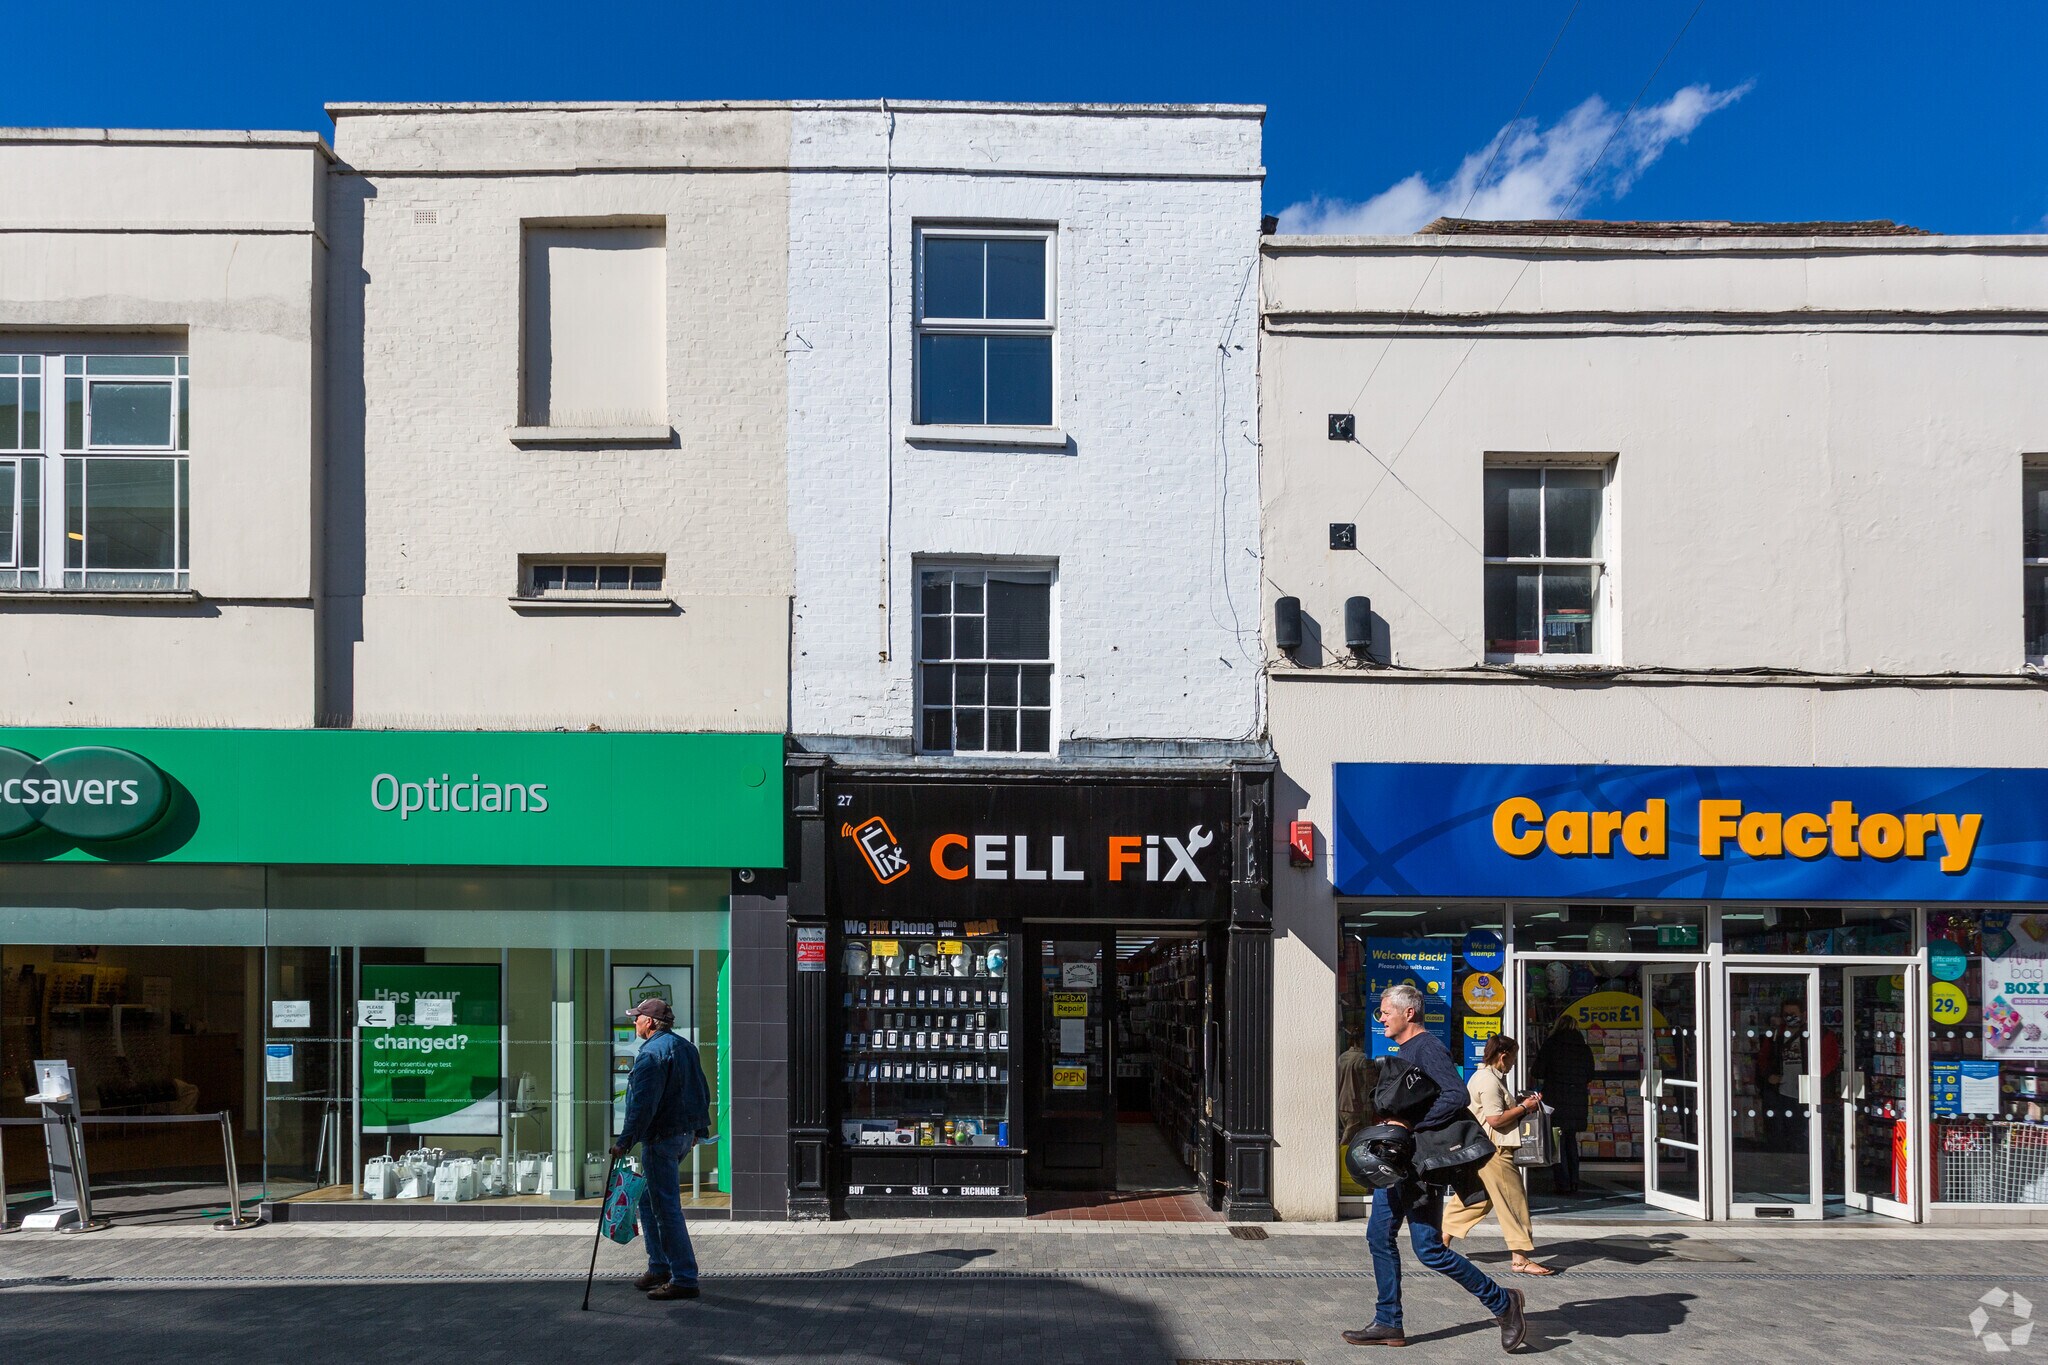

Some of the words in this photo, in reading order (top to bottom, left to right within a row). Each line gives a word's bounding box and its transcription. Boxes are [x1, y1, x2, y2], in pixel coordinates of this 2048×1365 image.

[0, 779, 139, 805] csavers
[371, 773, 548, 820] Opticians
[837, 795, 853, 806] 27
[1492, 796, 1666, 858] Card
[1699, 799, 1982, 873] Factory
[930, 834, 1085, 881] CELL
[844, 920, 866, 934] We
[869, 920, 889, 935] FIX
[891, 920, 934, 935] Phone
[938, 920, 957, 928] while
[799, 943, 824, 951] Alarm
[1372, 950, 1417, 961] Welcome
[1418, 952, 1447, 962] Back!
[1065, 964, 1094, 975] Vacancies
[2011, 963, 2043, 982] bag
[640, 990, 663, 999] OPEN
[2004, 982, 2040, 995] BOX
[375, 988, 409, 1004] Has
[1054, 994, 1071, 1002] SAME
[1071, 994, 1086, 1002] DAY
[1058, 1004, 1083, 1013] Repair
[1934, 998, 1960, 1014] 29p
[1579, 1007, 1589, 1023] 5
[1591, 1012, 1618, 1022] FOR
[1620, 1005, 1640, 1022] £1
[374, 1033, 468, 1054] changed?
[1054, 1072, 1085, 1082] OPEN
[848, 1186, 865, 1195] BUY
[912, 1187, 929, 1195] SELL
[960, 1187, 1000, 1196] EXCHANGE
